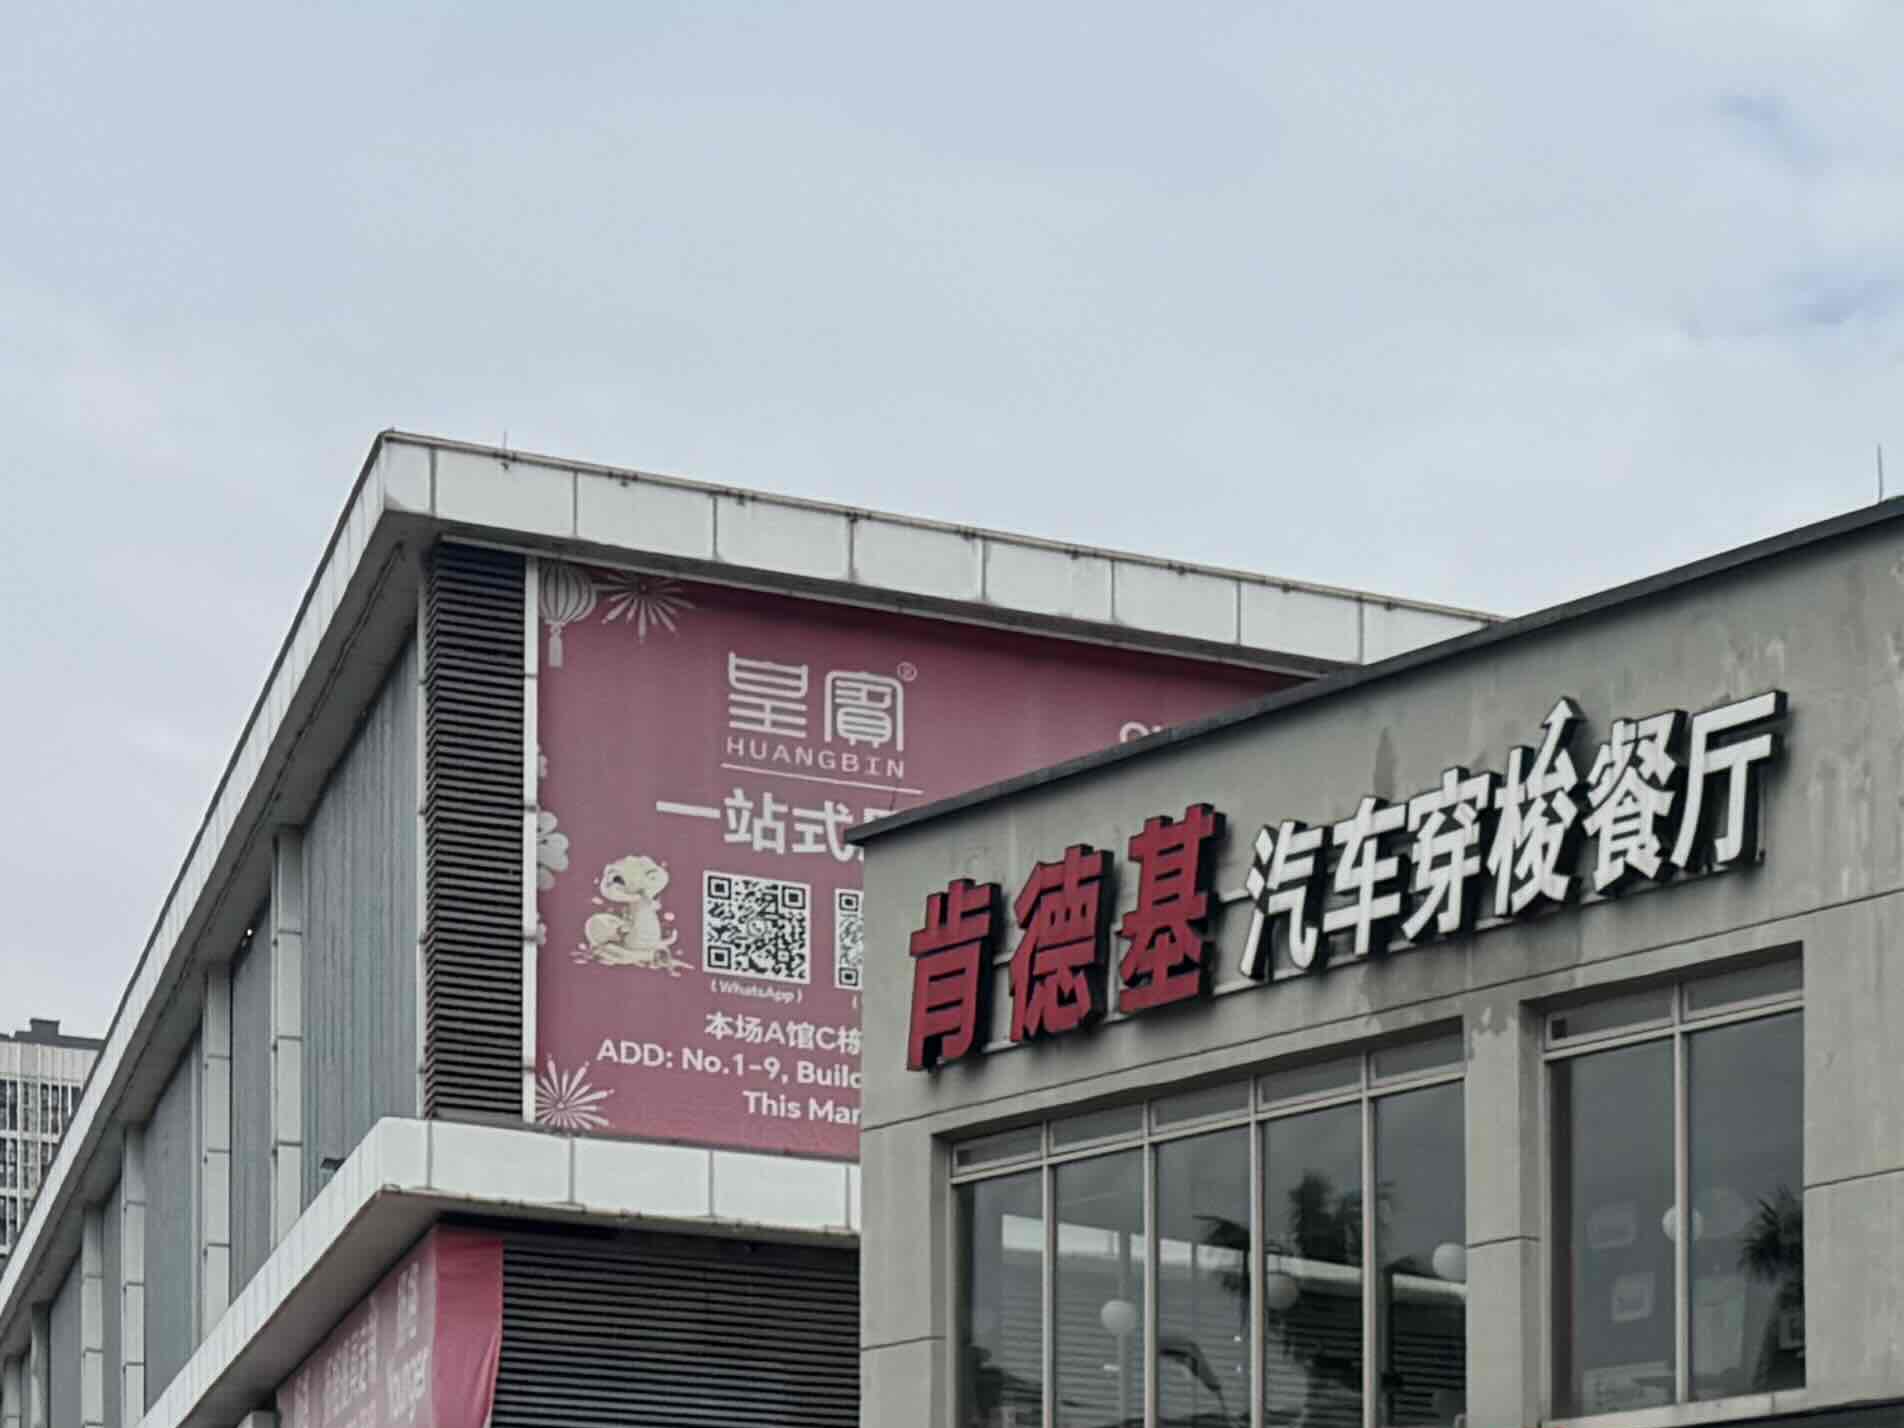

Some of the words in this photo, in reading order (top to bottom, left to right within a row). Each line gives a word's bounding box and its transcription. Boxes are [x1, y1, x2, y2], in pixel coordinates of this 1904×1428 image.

[726, 736, 905, 778] HUANGBIN
[656, 788, 888, 862] 一站式
[906, 802, 1222, 1072] 肯德基
[1238, 689, 1787, 980] 汽车穿梭餐厅
[596, 1039, 673, 1069] ADD:
[742, 1090, 801, 1119] This
[808, 1097, 862, 1126] Mar
